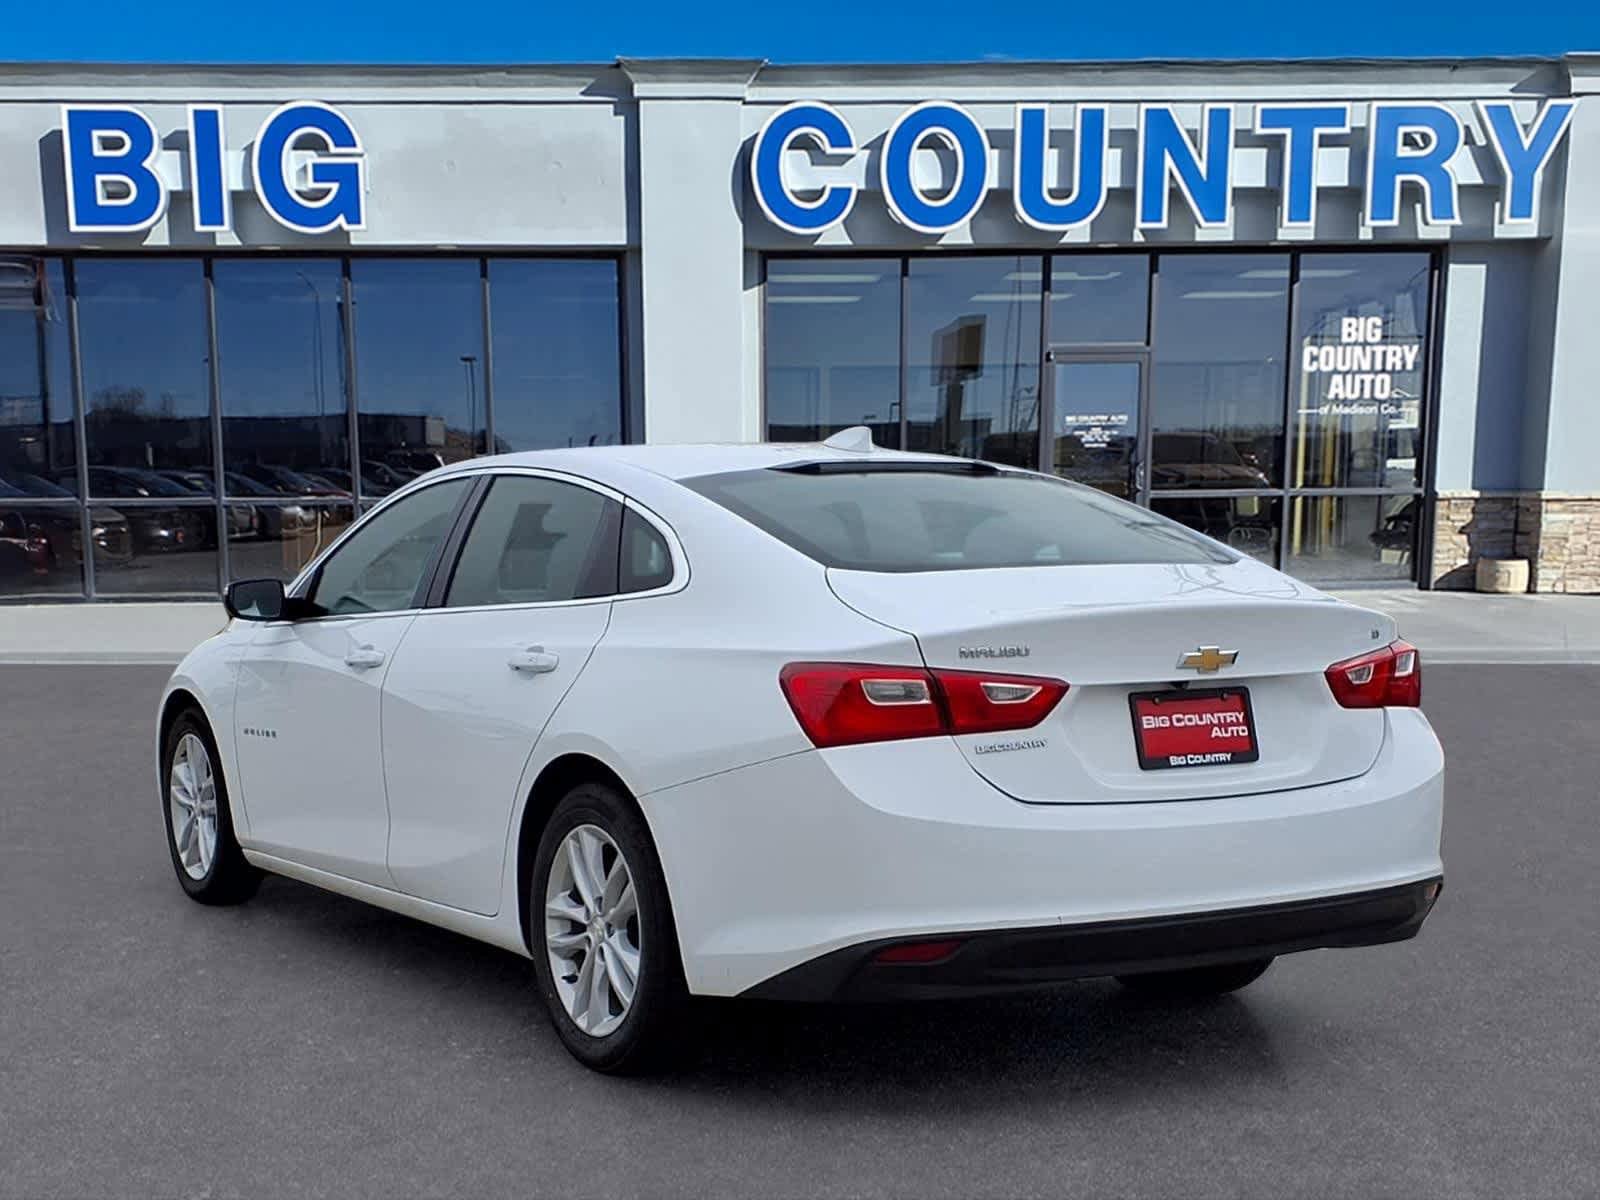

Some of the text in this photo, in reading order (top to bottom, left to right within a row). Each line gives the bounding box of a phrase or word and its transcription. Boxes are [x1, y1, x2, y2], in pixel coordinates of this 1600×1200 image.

[61, 100, 1576, 235] BIG COUNTRY
[1341, 316, 1383, 343] BIG
[1303, 345, 1419, 372] COUNTRY
[1328, 373, 1391, 400] AUTO
[1319, 404, 1330, 415] of
[1331, 404, 1378, 415] Madison
[959, 647, 1030, 659] MALIBU
[1142, 711, 1245, 729] BIG COUNTRY
[1211, 726, 1249, 738] AUTO
[1169, 752, 1232, 766] BIG COUNTRY
